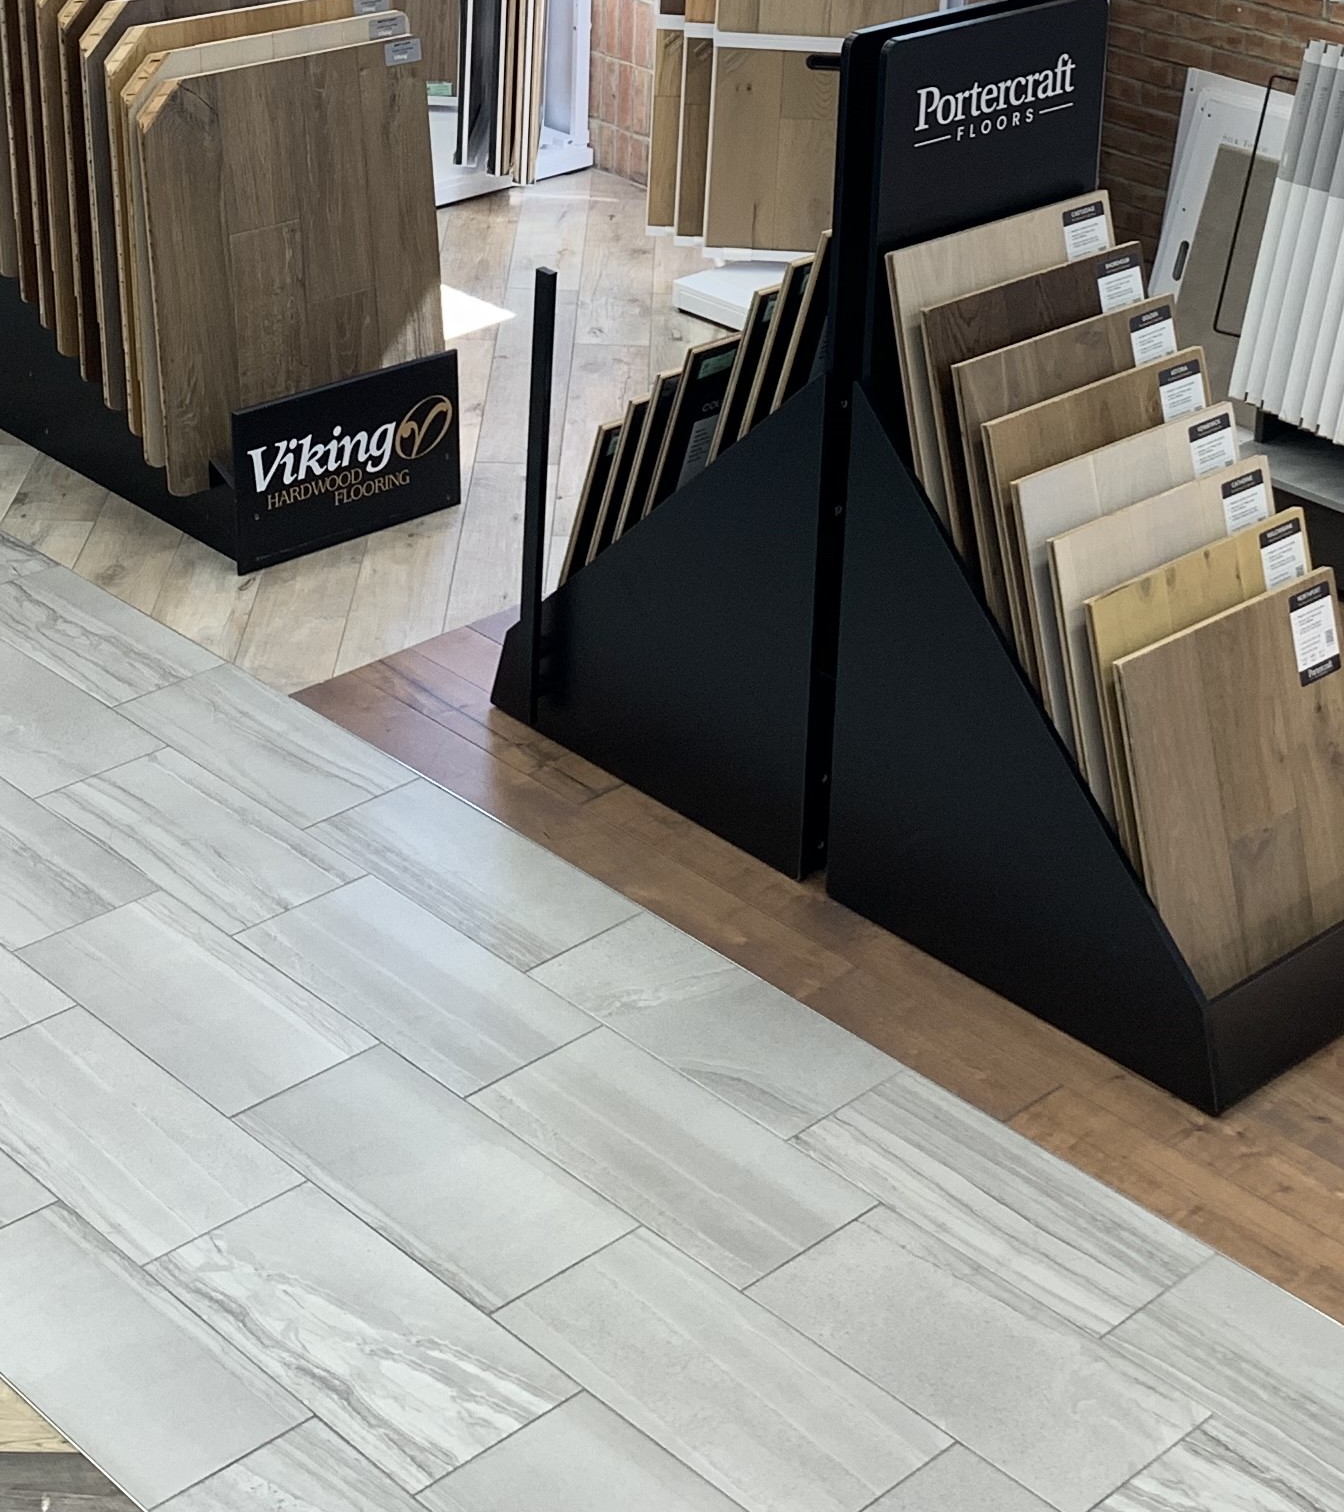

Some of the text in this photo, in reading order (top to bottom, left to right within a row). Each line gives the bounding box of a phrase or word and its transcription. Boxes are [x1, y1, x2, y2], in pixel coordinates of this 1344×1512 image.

[914, 53, 1076, 131] Portercraft
[956, 108, 1035, 141] FLOORS
[247, 421, 396, 493] Viking
[267, 468, 363, 510] HARDWOOD
[334, 469, 410, 506] FLOORING
